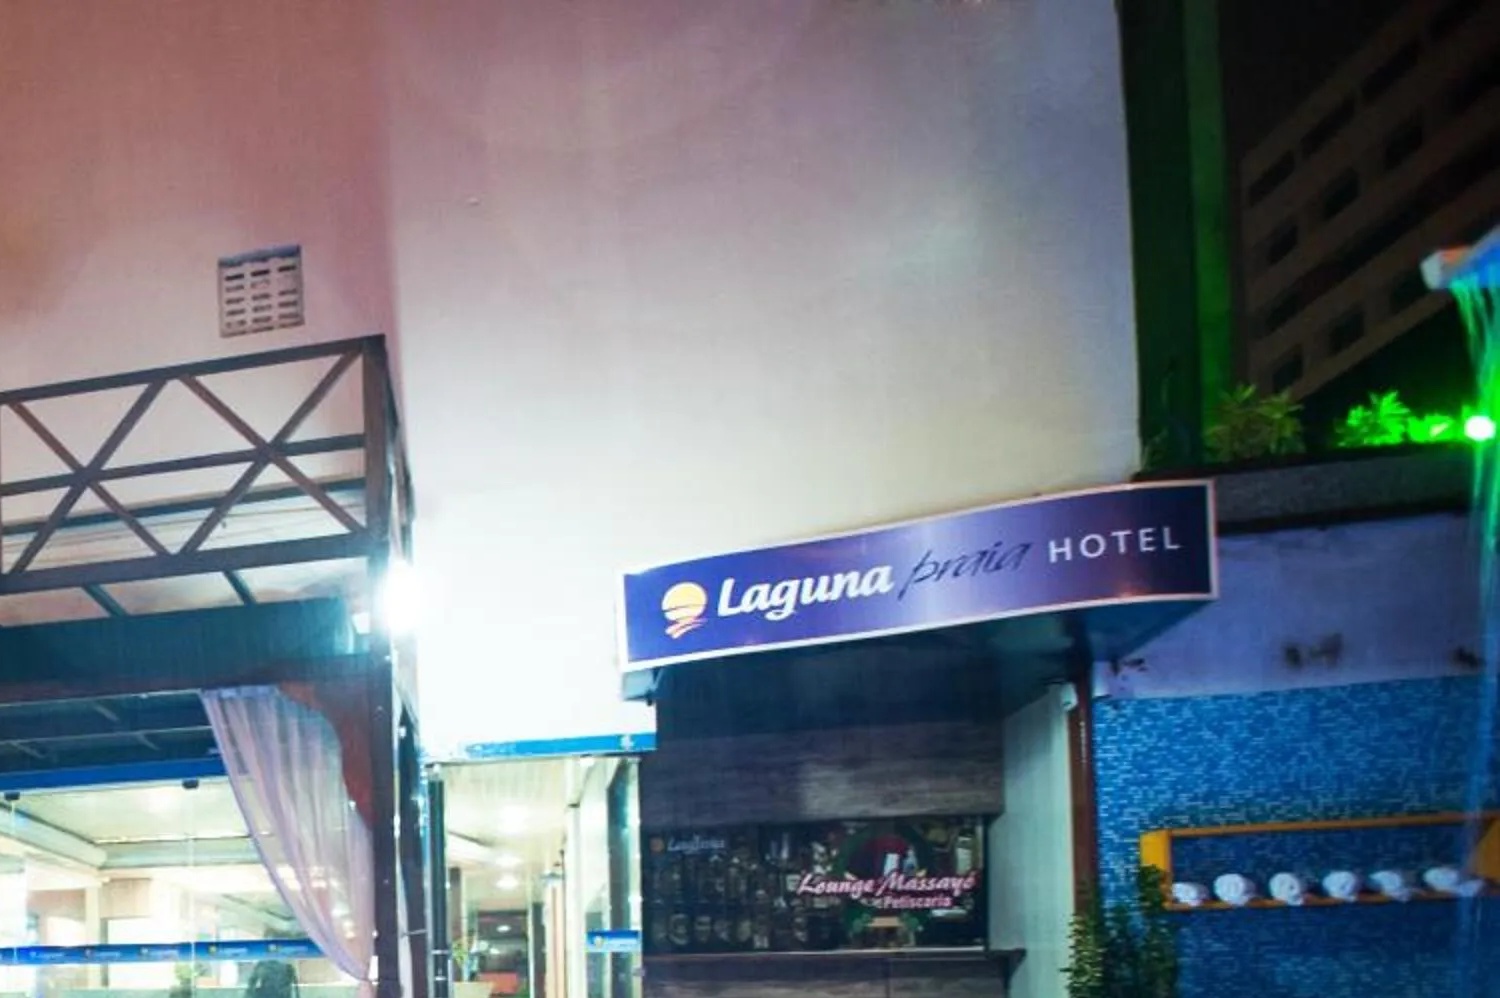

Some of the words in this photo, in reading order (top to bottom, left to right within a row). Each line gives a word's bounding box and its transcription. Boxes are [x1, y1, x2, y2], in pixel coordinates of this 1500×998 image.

[718, 564, 894, 621] Laguna
[897, 541, 1032, 602] praia
[1048, 527, 1181, 563] HOTEL
[797, 872, 875, 898] Lounge
